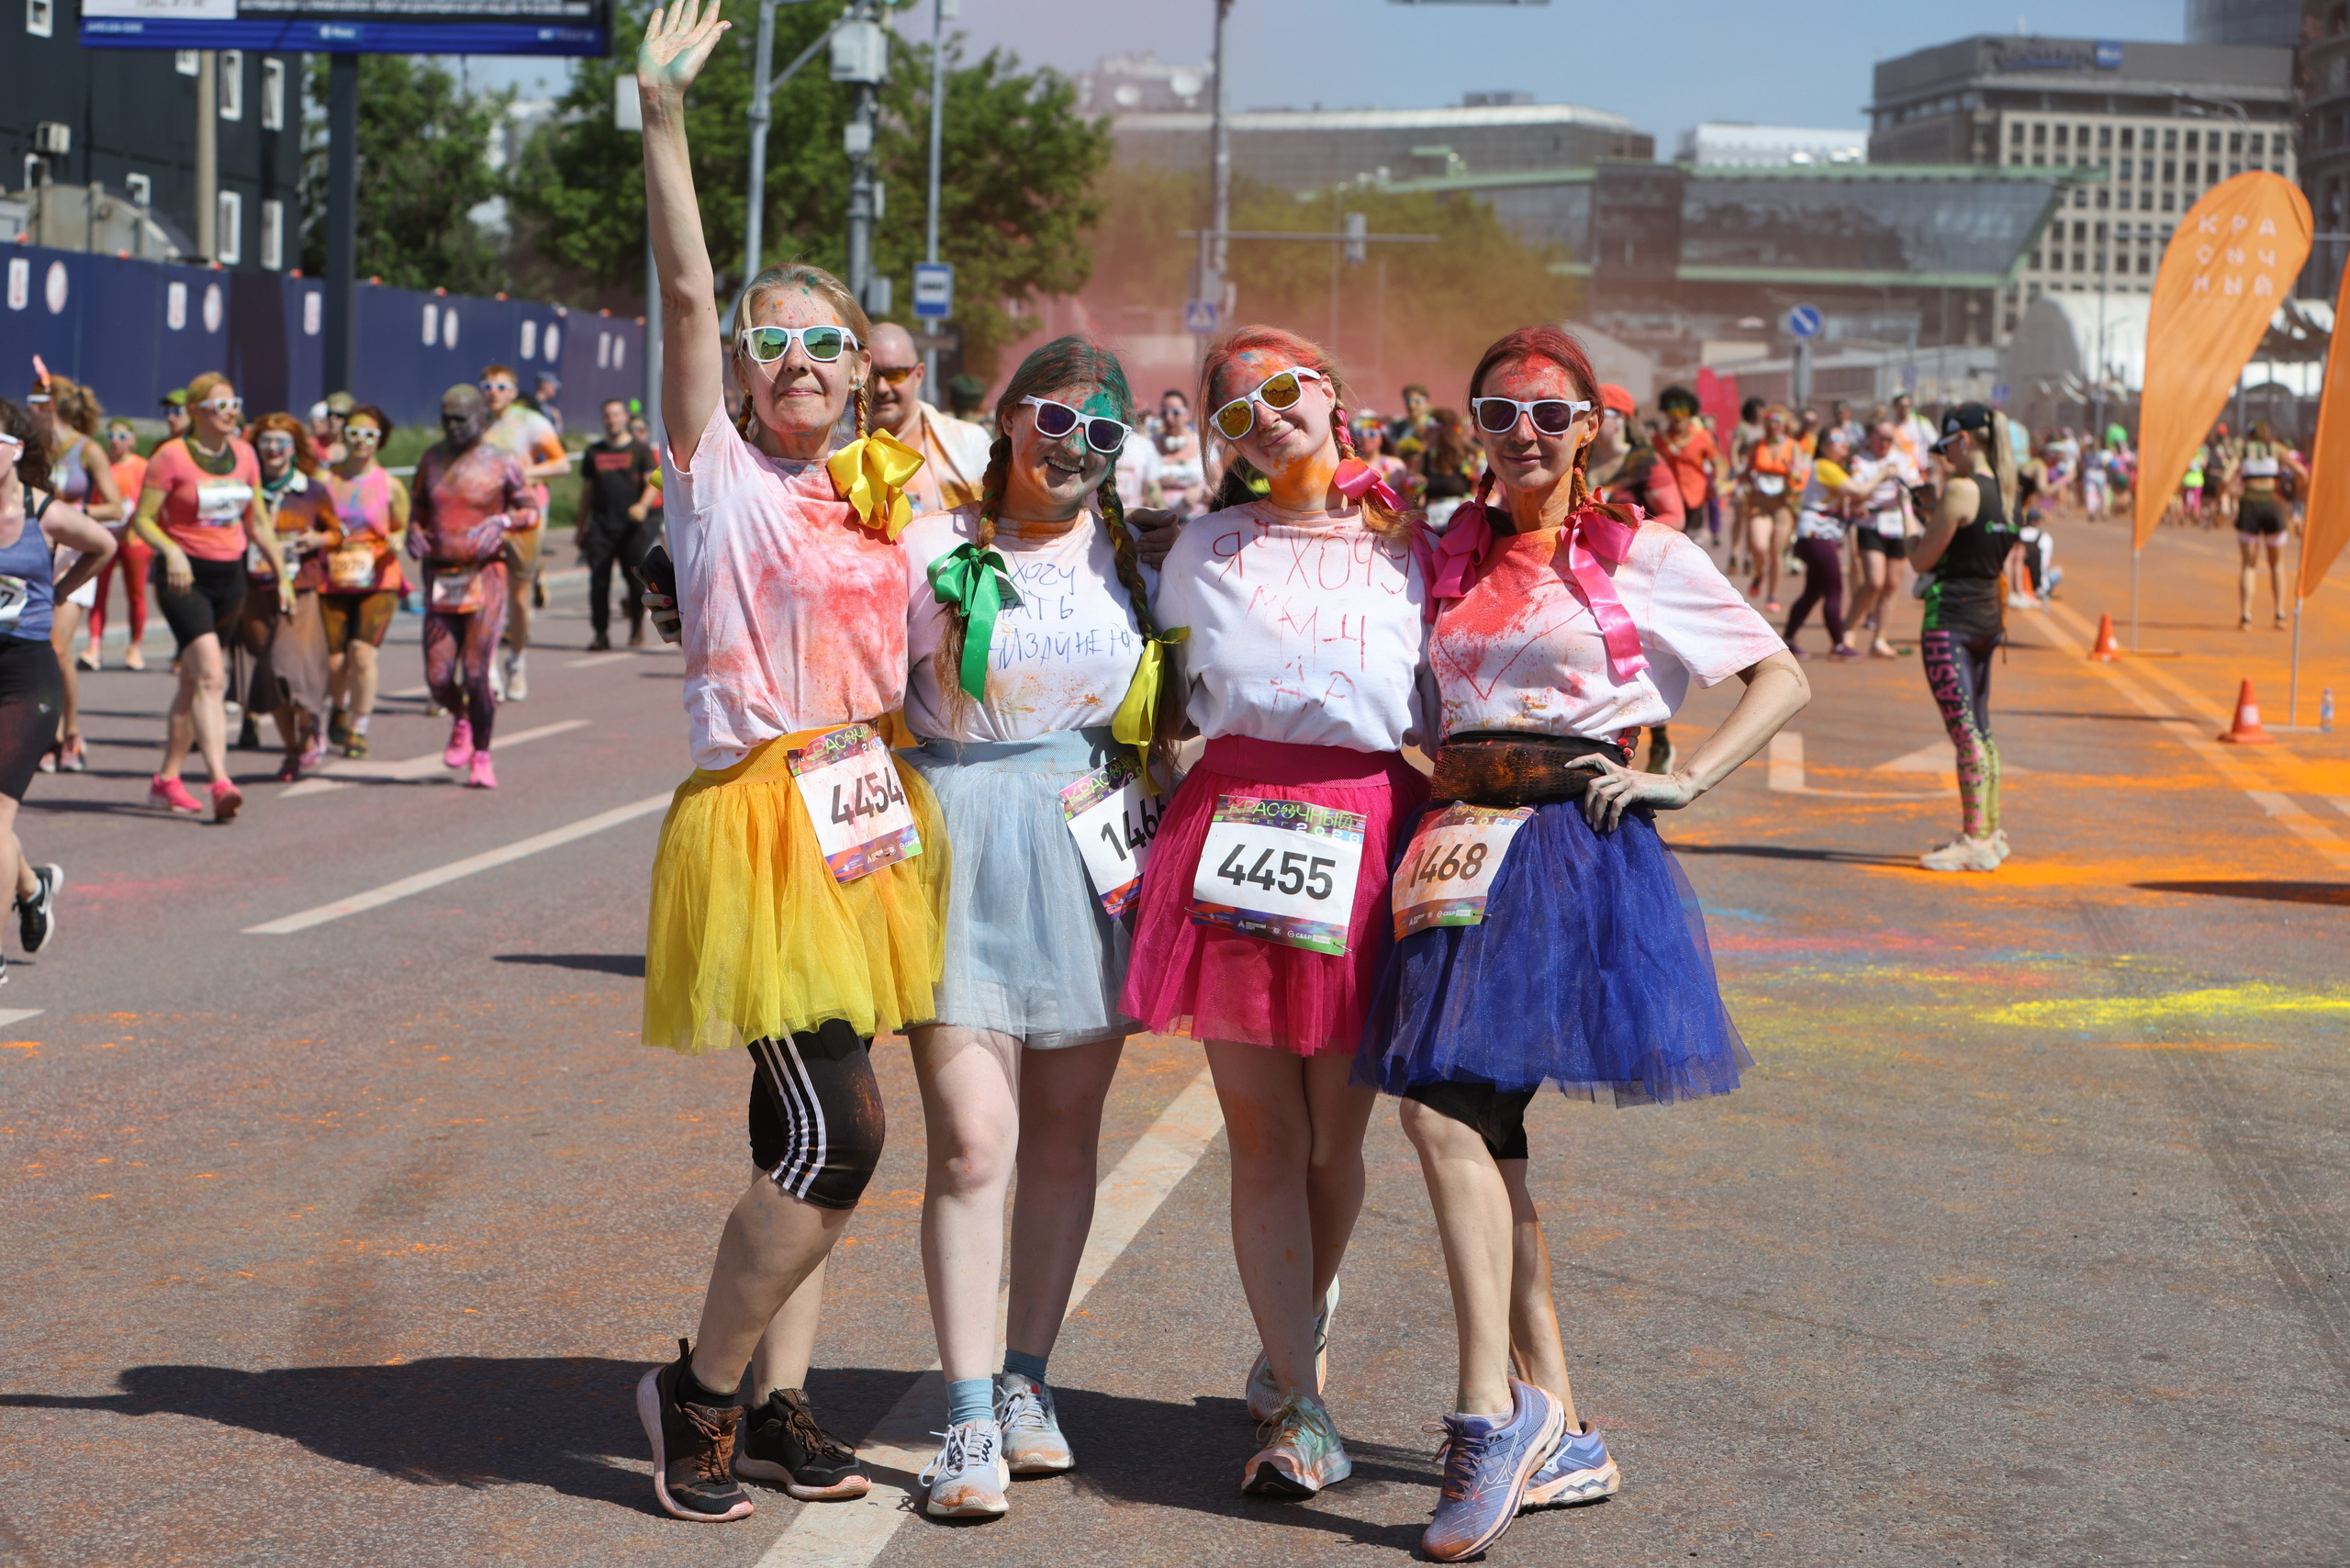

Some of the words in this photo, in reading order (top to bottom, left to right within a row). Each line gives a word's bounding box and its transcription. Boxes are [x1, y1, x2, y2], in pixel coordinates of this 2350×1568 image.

[1925, 630, 1965, 720] FASHI
[831, 767, 905, 826] 4454
[1227, 800, 1354, 831] КРАСОЧНЫЙ
[1225, 816, 1290, 826] ЗАБЕГ
[1295, 823, 1361, 845] 2026
[1463, 816, 1521, 826] 2026
[1216, 844, 1337, 901] 4455
[1409, 842, 1488, 889] 1468
